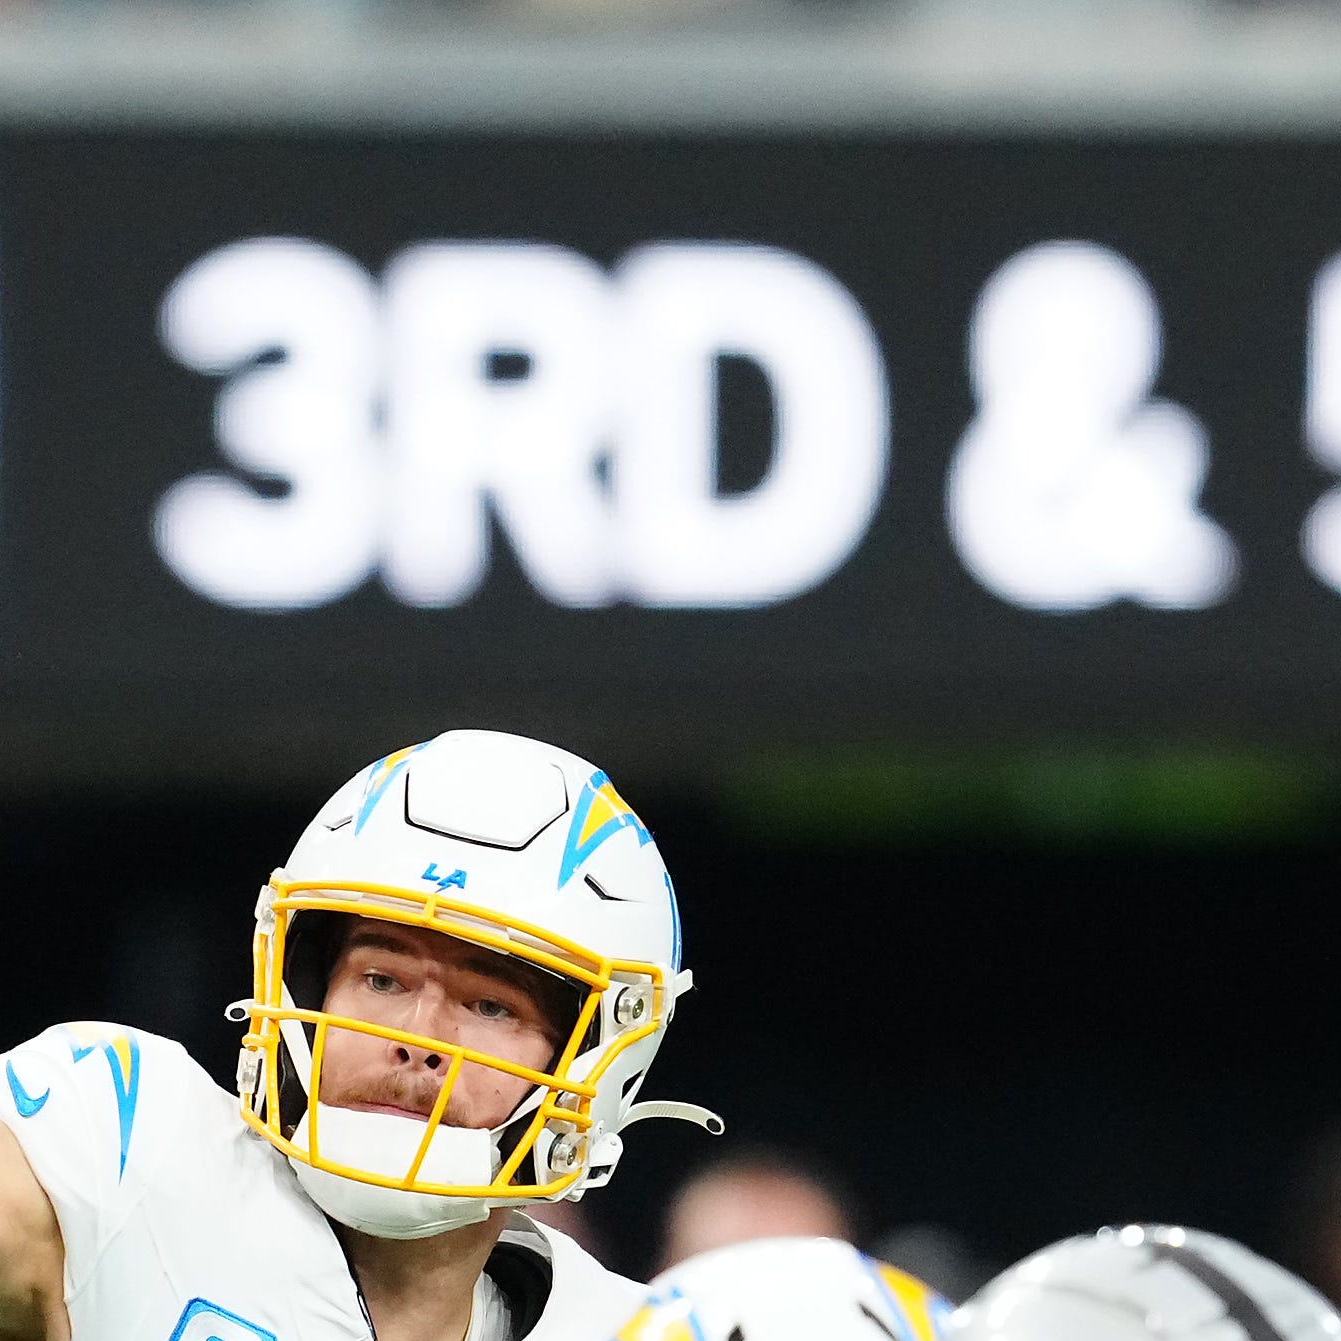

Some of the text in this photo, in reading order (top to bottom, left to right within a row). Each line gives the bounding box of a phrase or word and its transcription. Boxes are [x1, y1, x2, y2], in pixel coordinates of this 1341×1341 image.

[152, 236, 891, 611] 3RD
[947, 240, 1237, 611] &
[421, 862, 467, 893] LA
